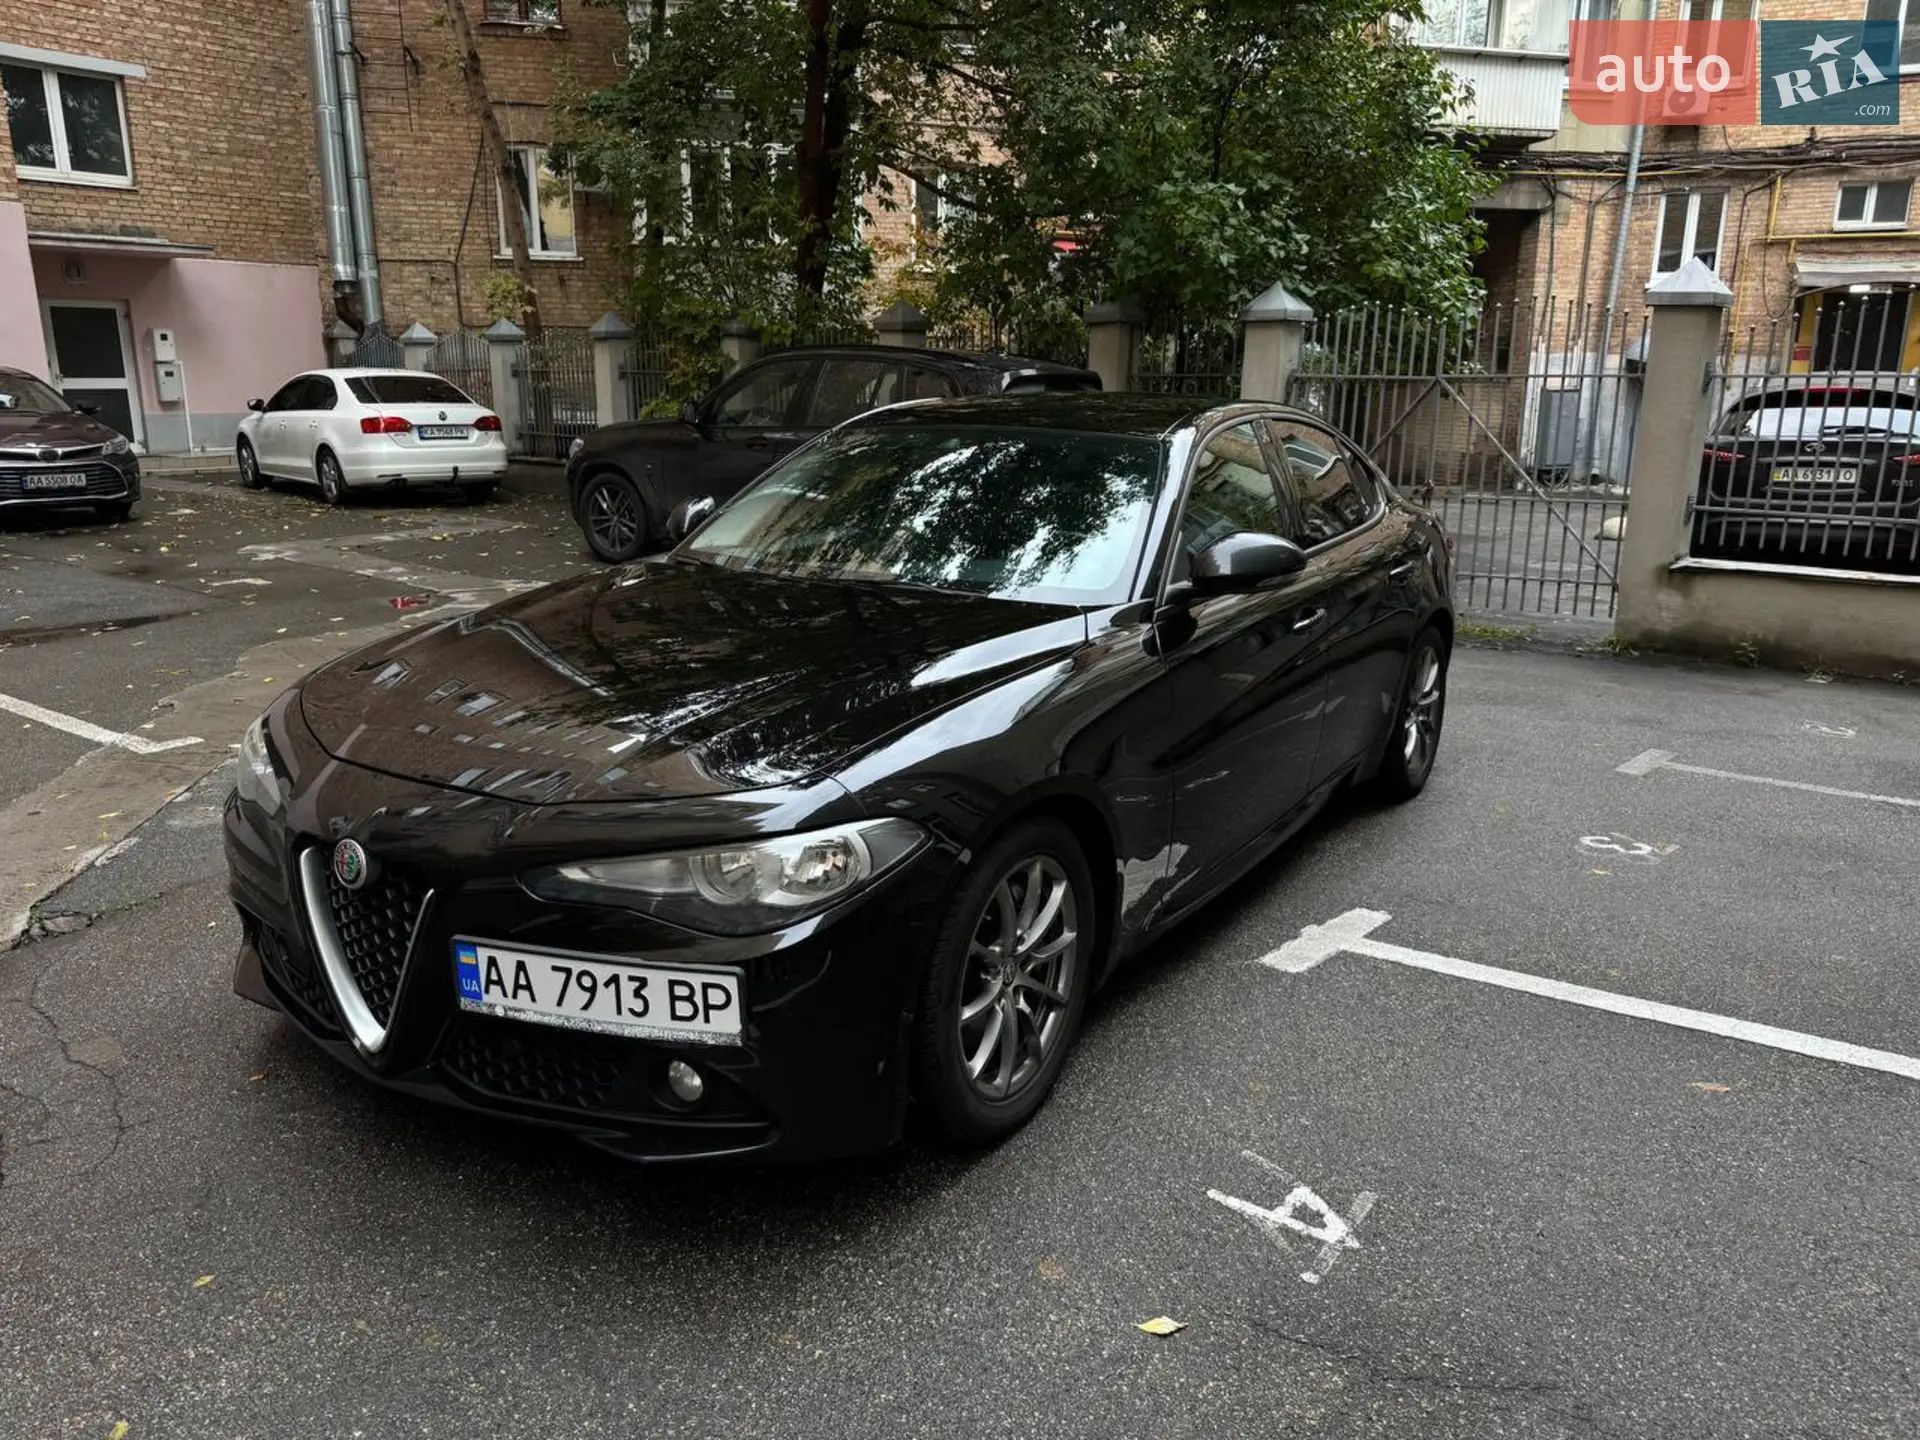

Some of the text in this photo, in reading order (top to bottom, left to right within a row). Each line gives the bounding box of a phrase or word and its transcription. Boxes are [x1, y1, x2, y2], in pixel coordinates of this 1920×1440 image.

[29, 476, 43, 485] AA
[462, 977, 480, 993] UA
[484, 955, 732, 1024] AA 7913 BP
